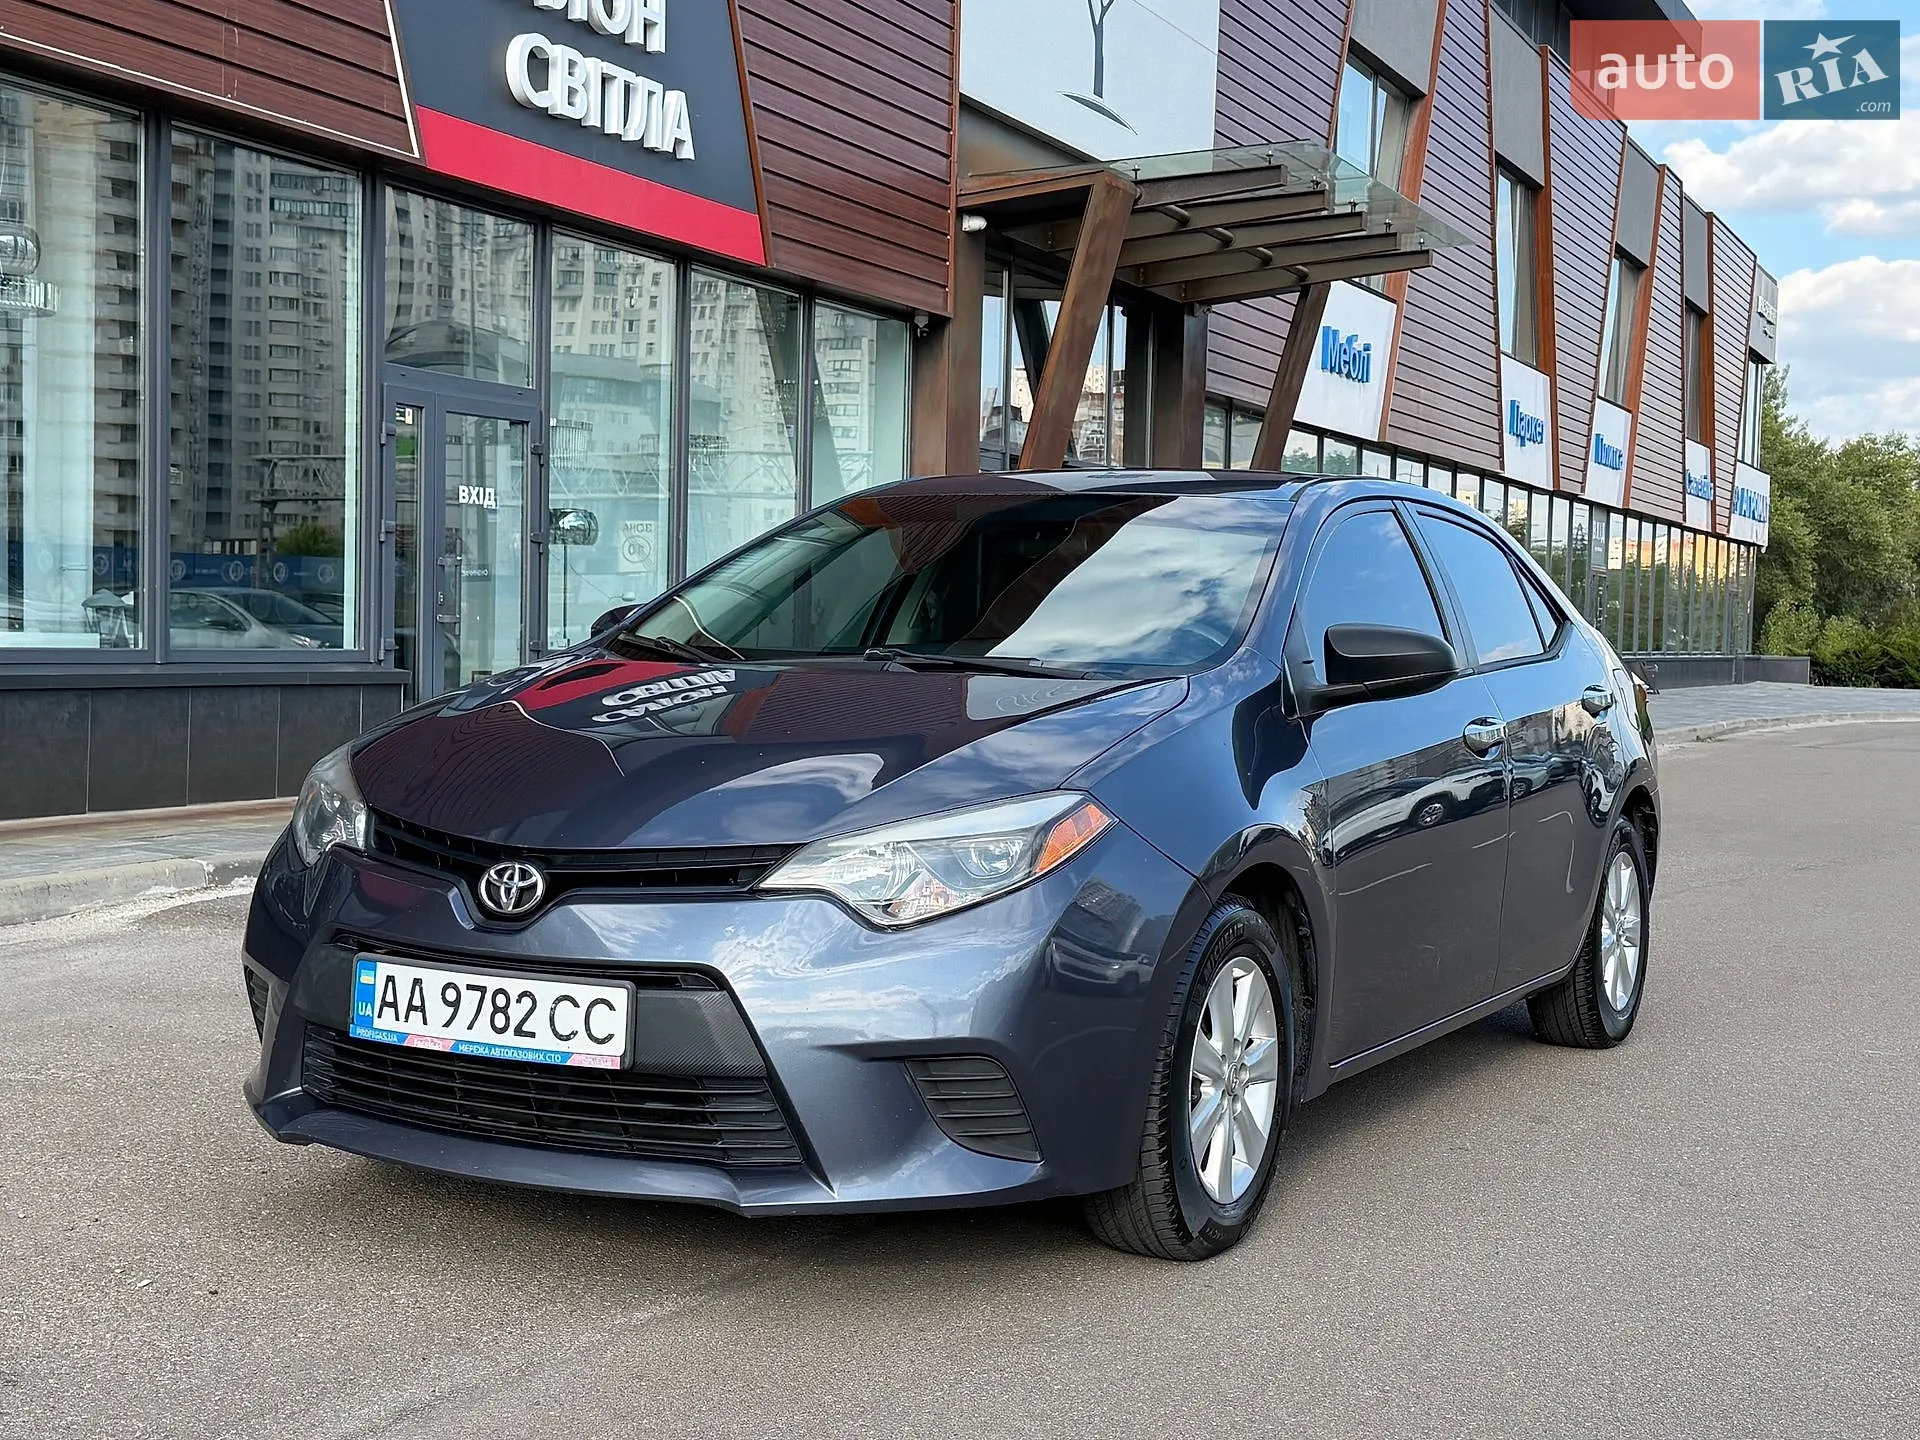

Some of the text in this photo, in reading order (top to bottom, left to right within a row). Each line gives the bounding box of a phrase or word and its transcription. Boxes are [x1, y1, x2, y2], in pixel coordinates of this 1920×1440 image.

[505, 32, 695, 160] СВІТЛА
[1321, 326, 1371, 383] Меблі
[458, 485, 497, 509] ВХІД
[358, 1002, 372, 1017] UA
[377, 975, 617, 1045] AA 9782 CC
[546, 1053, 562, 1063] СТО
